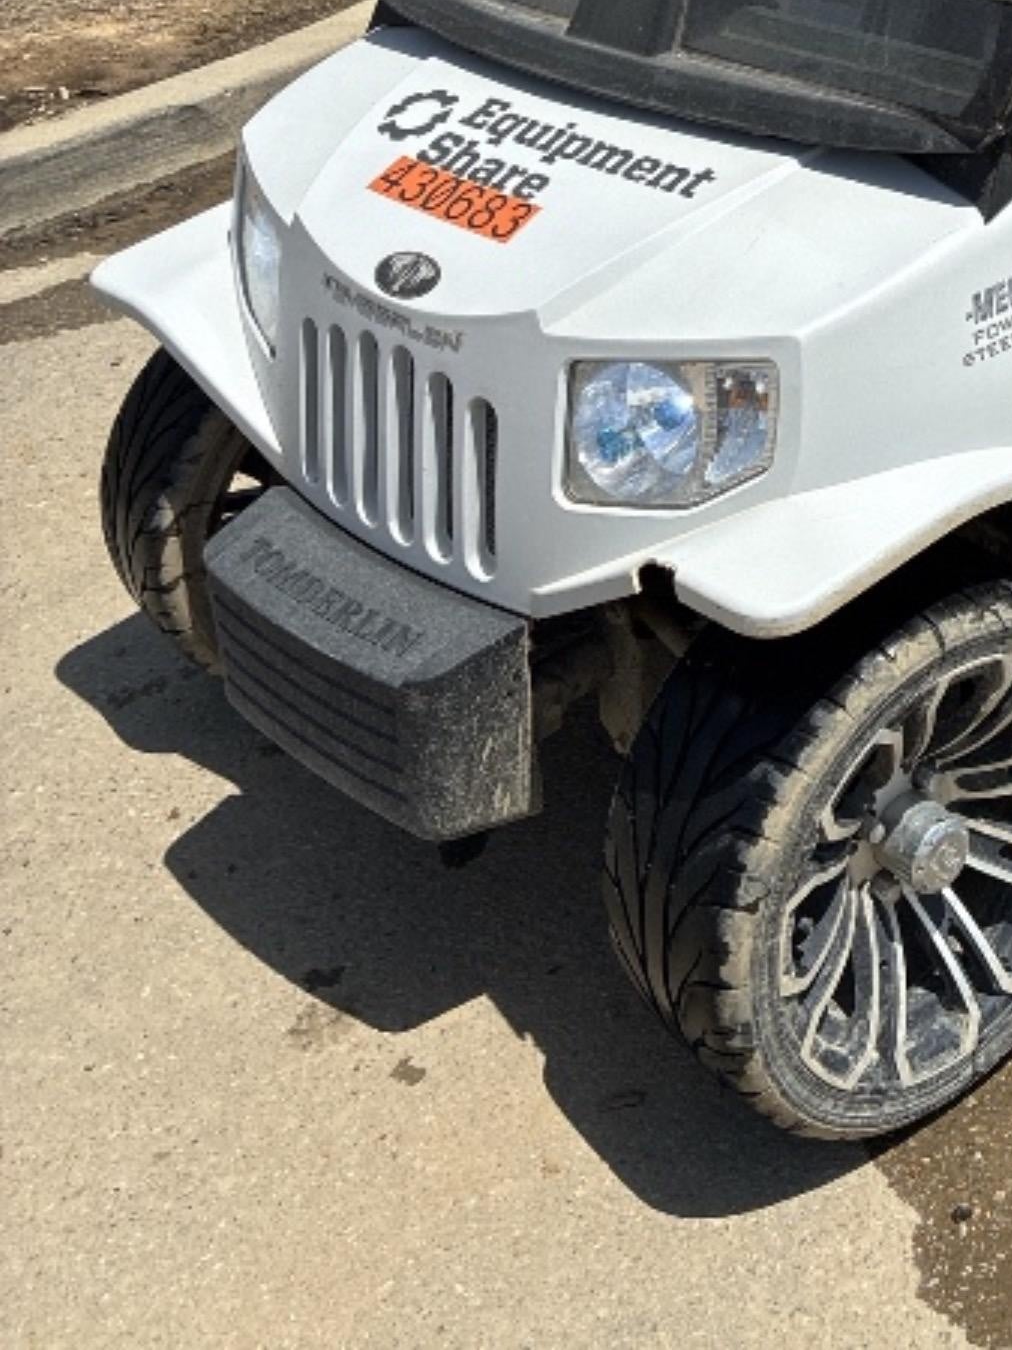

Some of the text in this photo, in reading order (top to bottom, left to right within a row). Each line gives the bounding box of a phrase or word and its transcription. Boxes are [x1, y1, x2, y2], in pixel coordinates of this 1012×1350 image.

[416, 131, 551, 200] Share
[458, 97, 716, 199] Equipment
[379, 161, 533, 240] 430683
